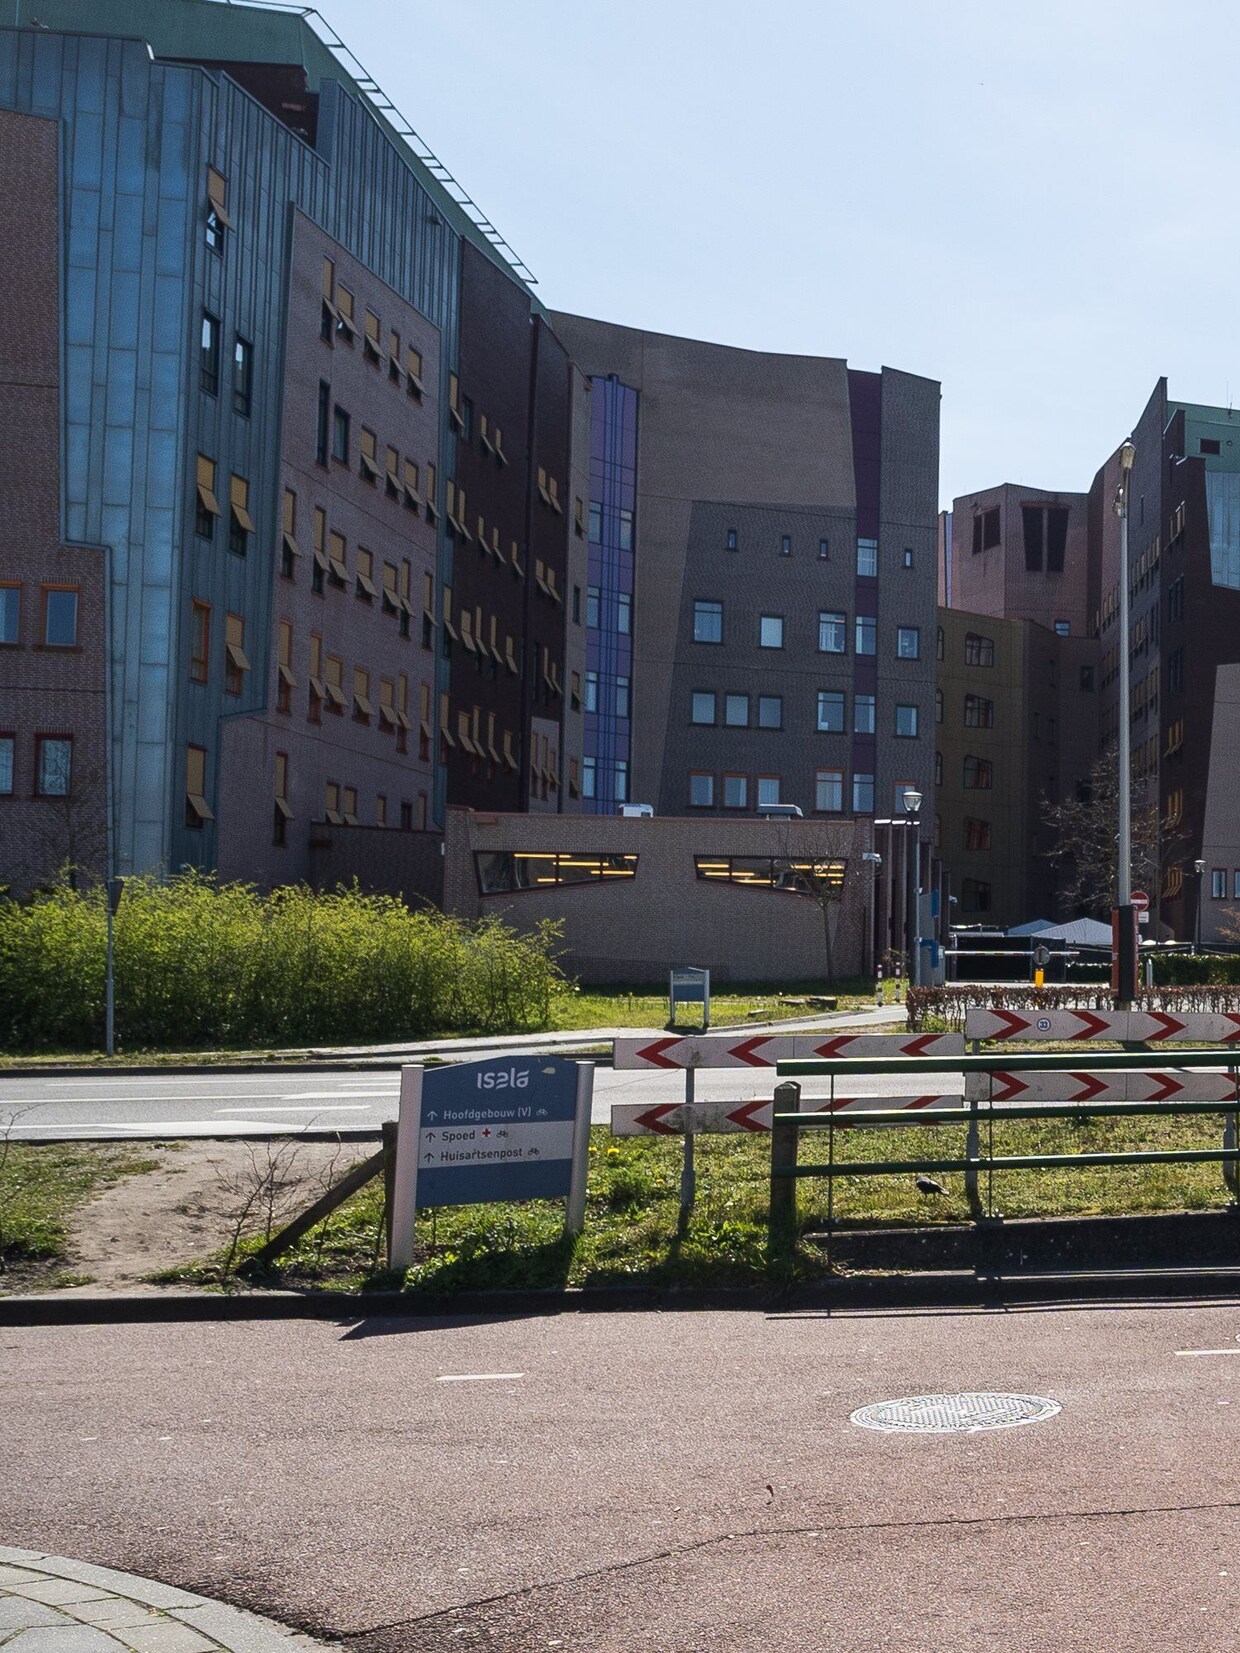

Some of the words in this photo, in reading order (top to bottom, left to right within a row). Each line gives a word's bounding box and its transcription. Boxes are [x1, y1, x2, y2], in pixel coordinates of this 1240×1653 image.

[443, 1109, 515, 1121] Hoofdgebouw
[441, 1129, 476, 1142] Spoed
[440, 1147, 523, 1162] Huisartsenpost
